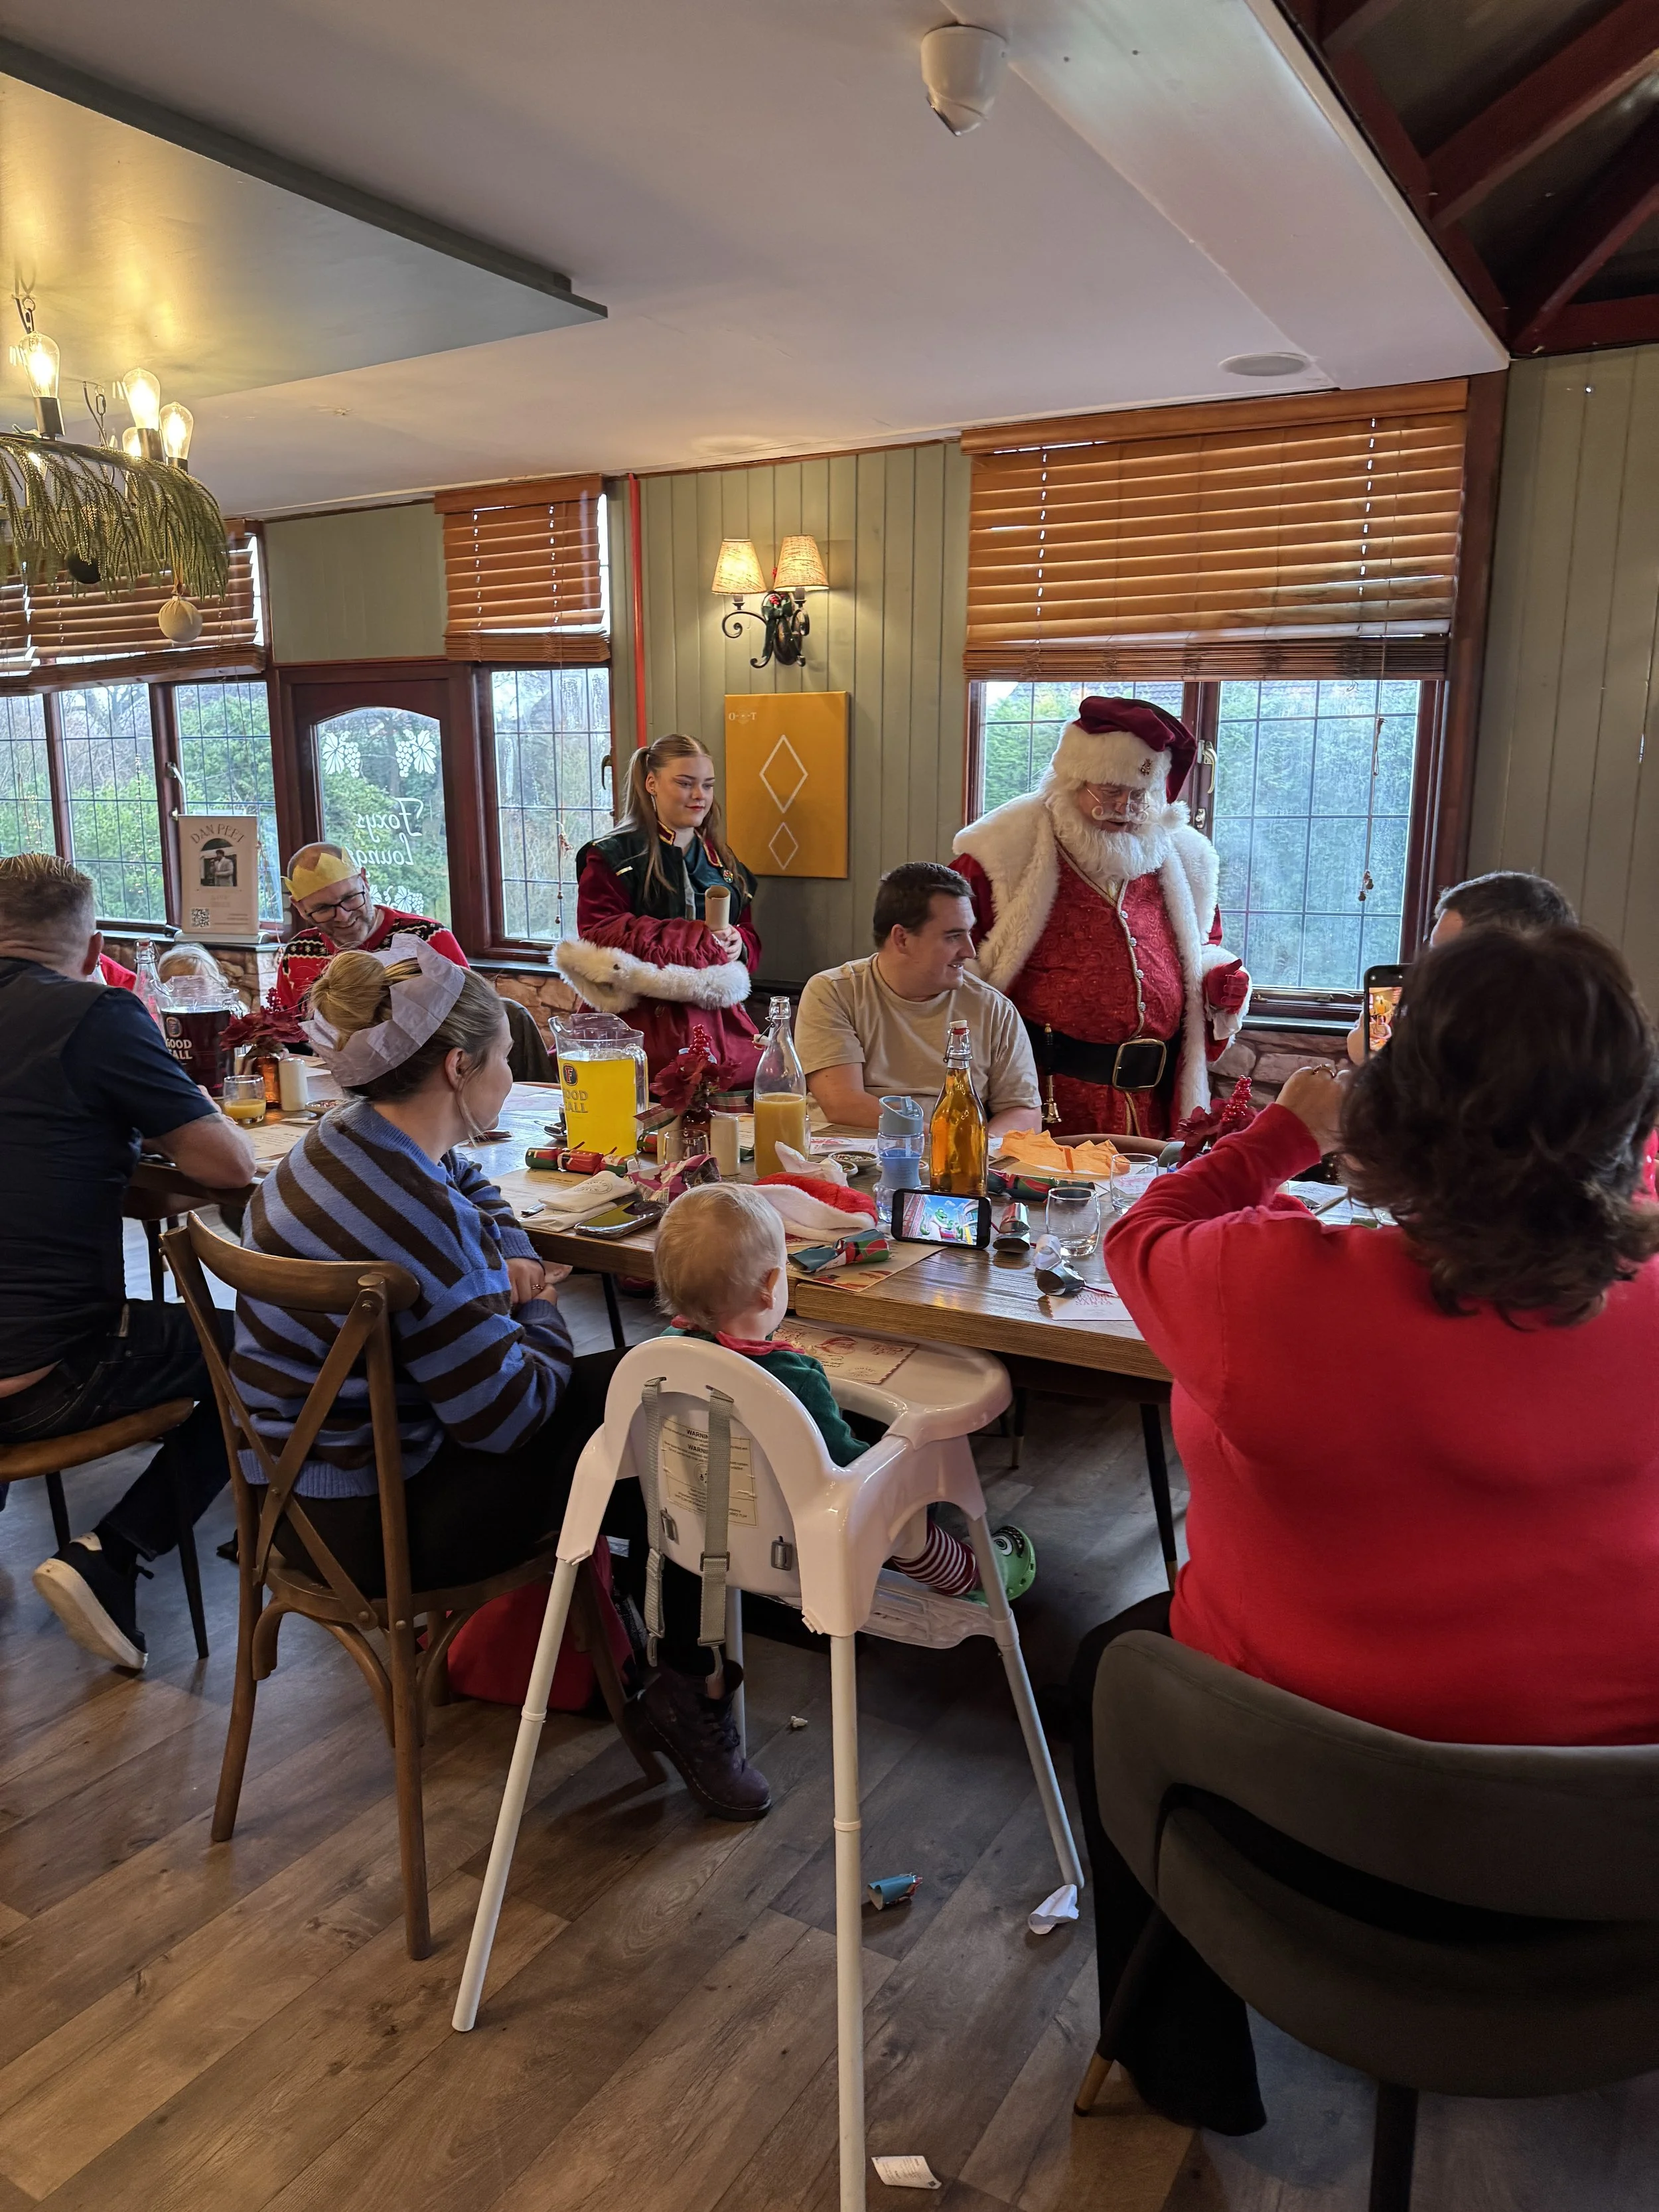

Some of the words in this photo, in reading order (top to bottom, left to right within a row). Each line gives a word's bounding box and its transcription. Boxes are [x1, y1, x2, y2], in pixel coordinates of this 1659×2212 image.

[190, 824, 215, 844] DAN
[217, 823, 246, 844] PEET
[168, 1049, 193, 1060] ALL
[565, 1066, 573, 1083] F
[687, 1443, 709, 1455] WARNI
